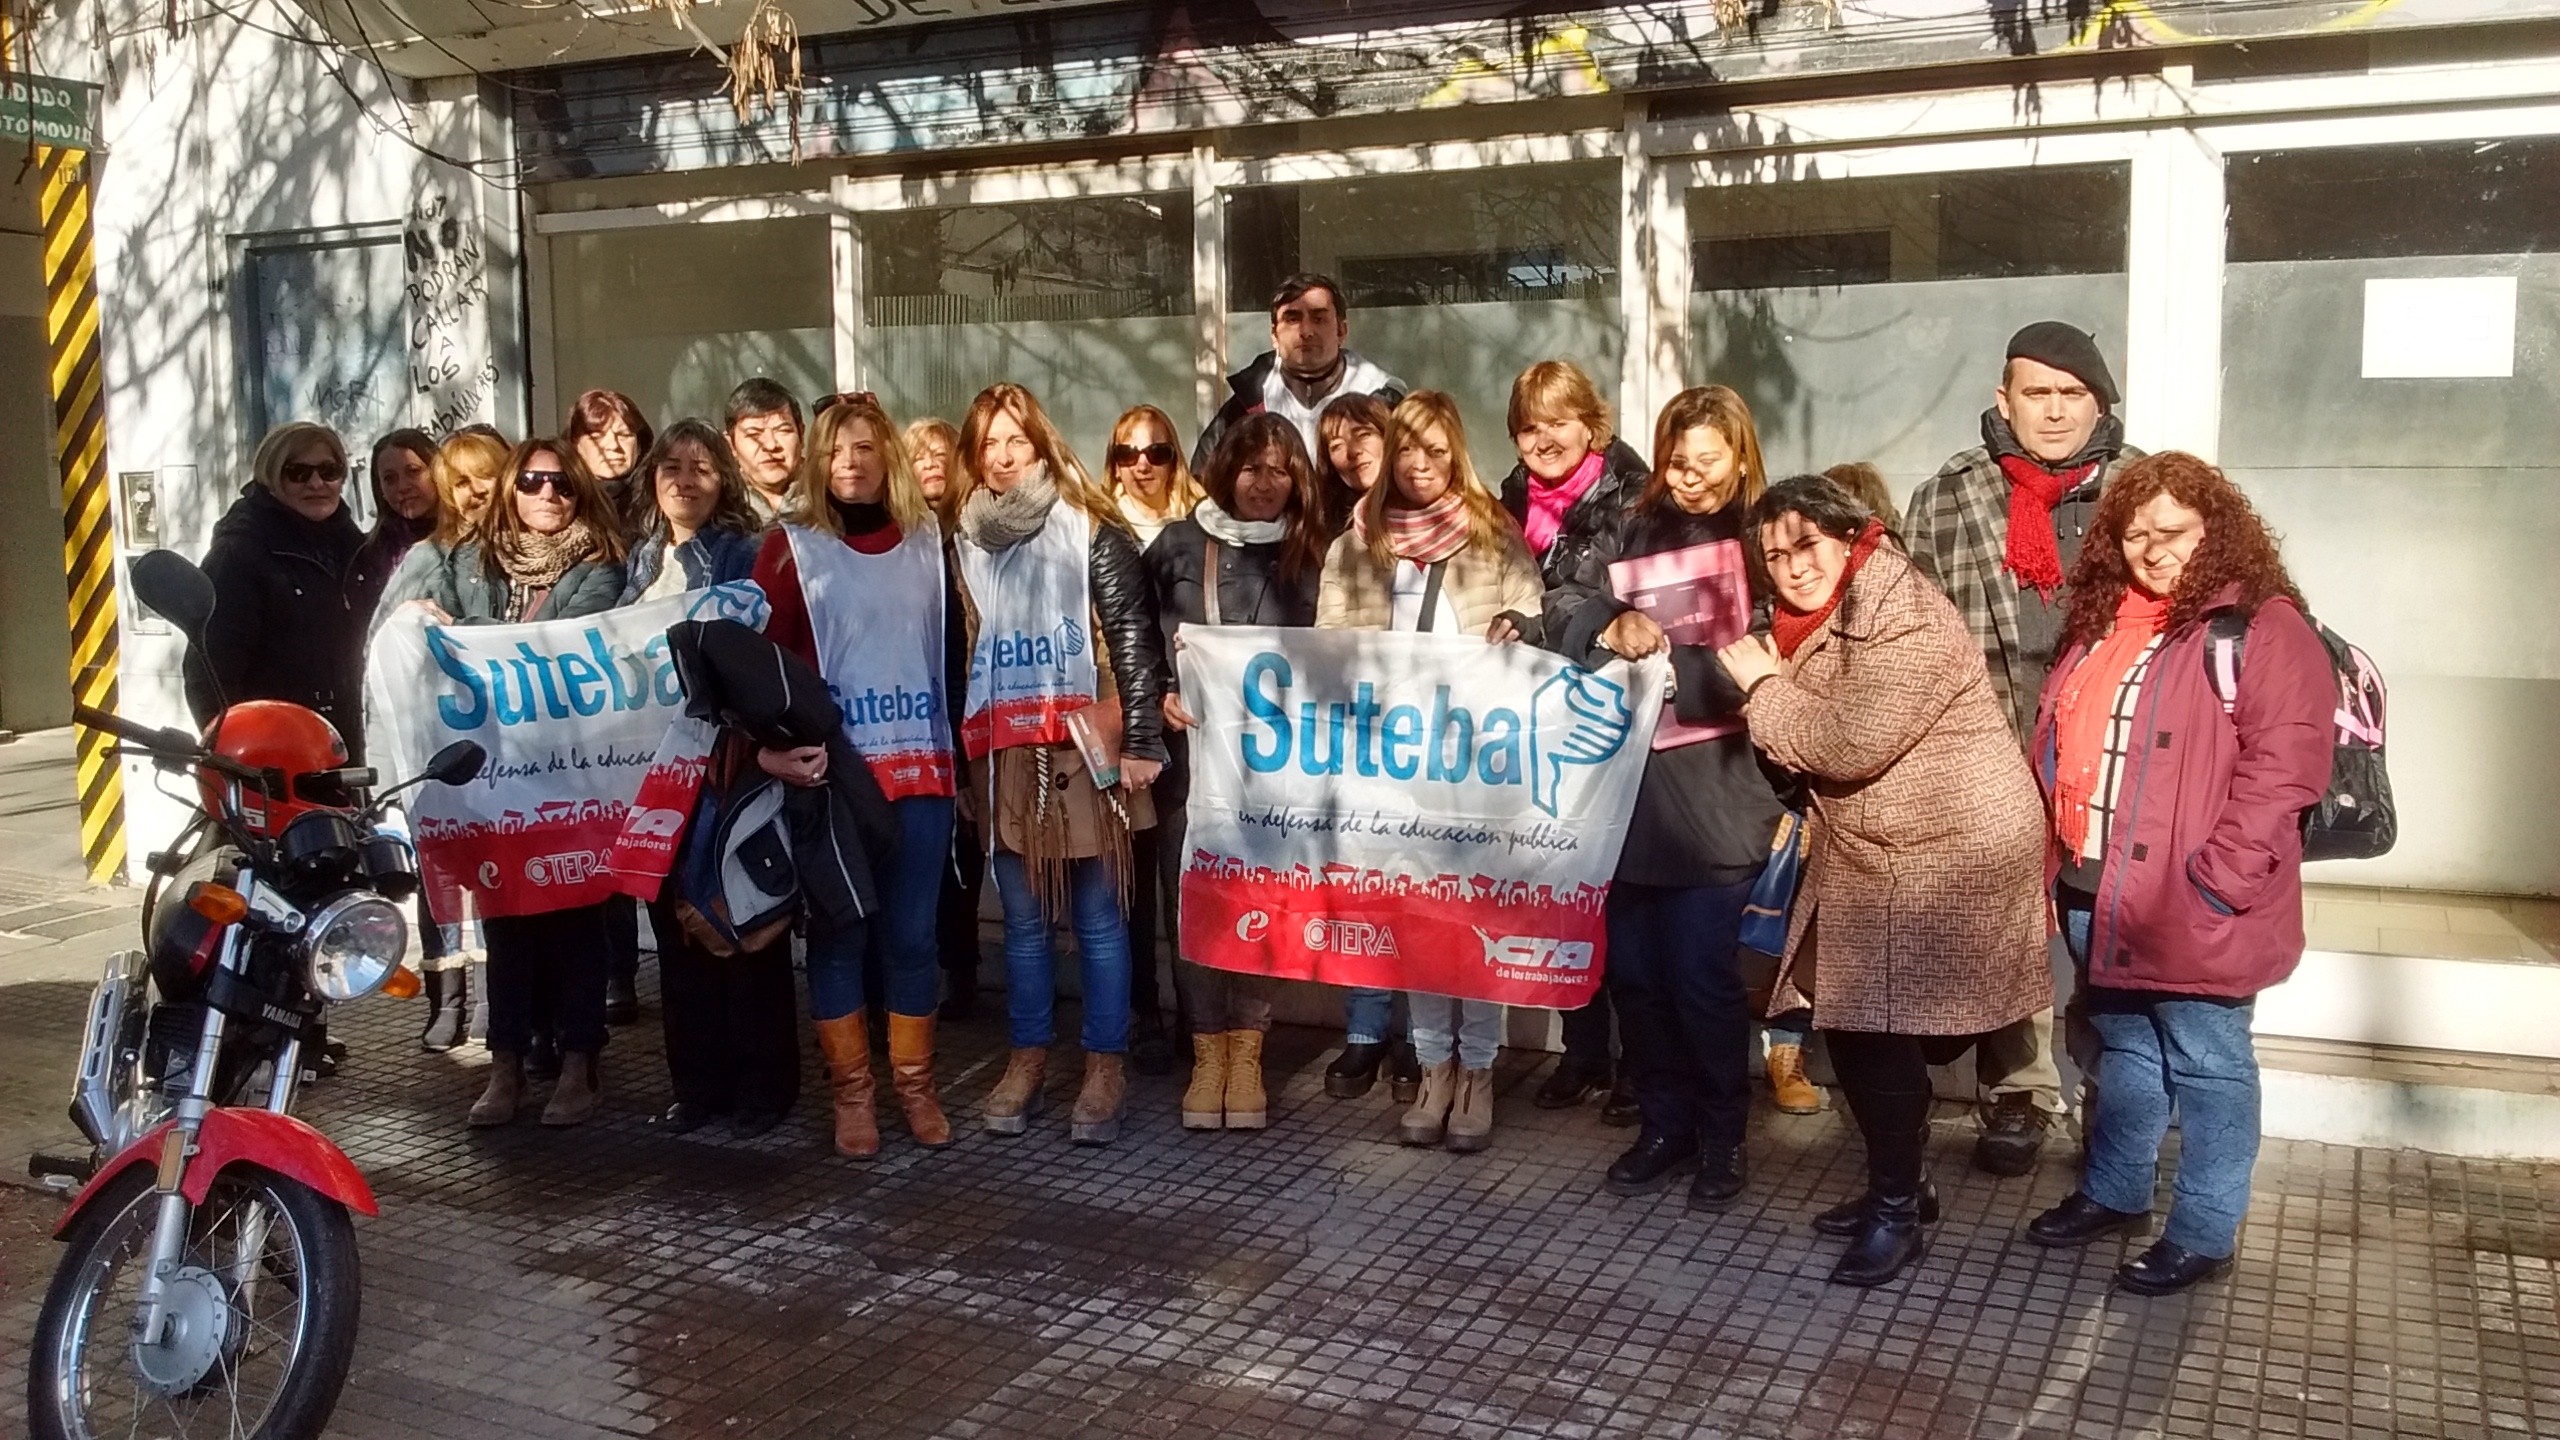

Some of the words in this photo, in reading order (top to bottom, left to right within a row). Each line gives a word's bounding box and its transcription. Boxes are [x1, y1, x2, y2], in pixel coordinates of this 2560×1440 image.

[0, 115, 92, 143] TOMOVIL
[407, 236, 480, 307] PODRAN
[411, 275, 490, 350] CALLAR
[440, 335, 455, 356] A
[412, 355, 461, 394] LOS
[424, 624, 682, 731] Suteba
[1240, 651, 1523, 786] Suteba
[475, 756, 542, 790] efensa
[549, 751, 568, 774] de
[571, 746, 592, 770] la
[597, 744, 656, 768] educac
[1238, 808, 1257, 824] en
[1261, 805, 1334, 839] defensa
[1339, 809, 1363, 833] de
[1369, 811, 1392, 836] la
[1399, 814, 1502, 846] educación
[1508, 822, 1580, 856] pública
[1303, 917, 1401, 960] CTERA
[1496, 935, 1595, 970] CTA
[1496, 966, 1507, 978] de
[262, 1002, 302, 1030] YAMAHA
